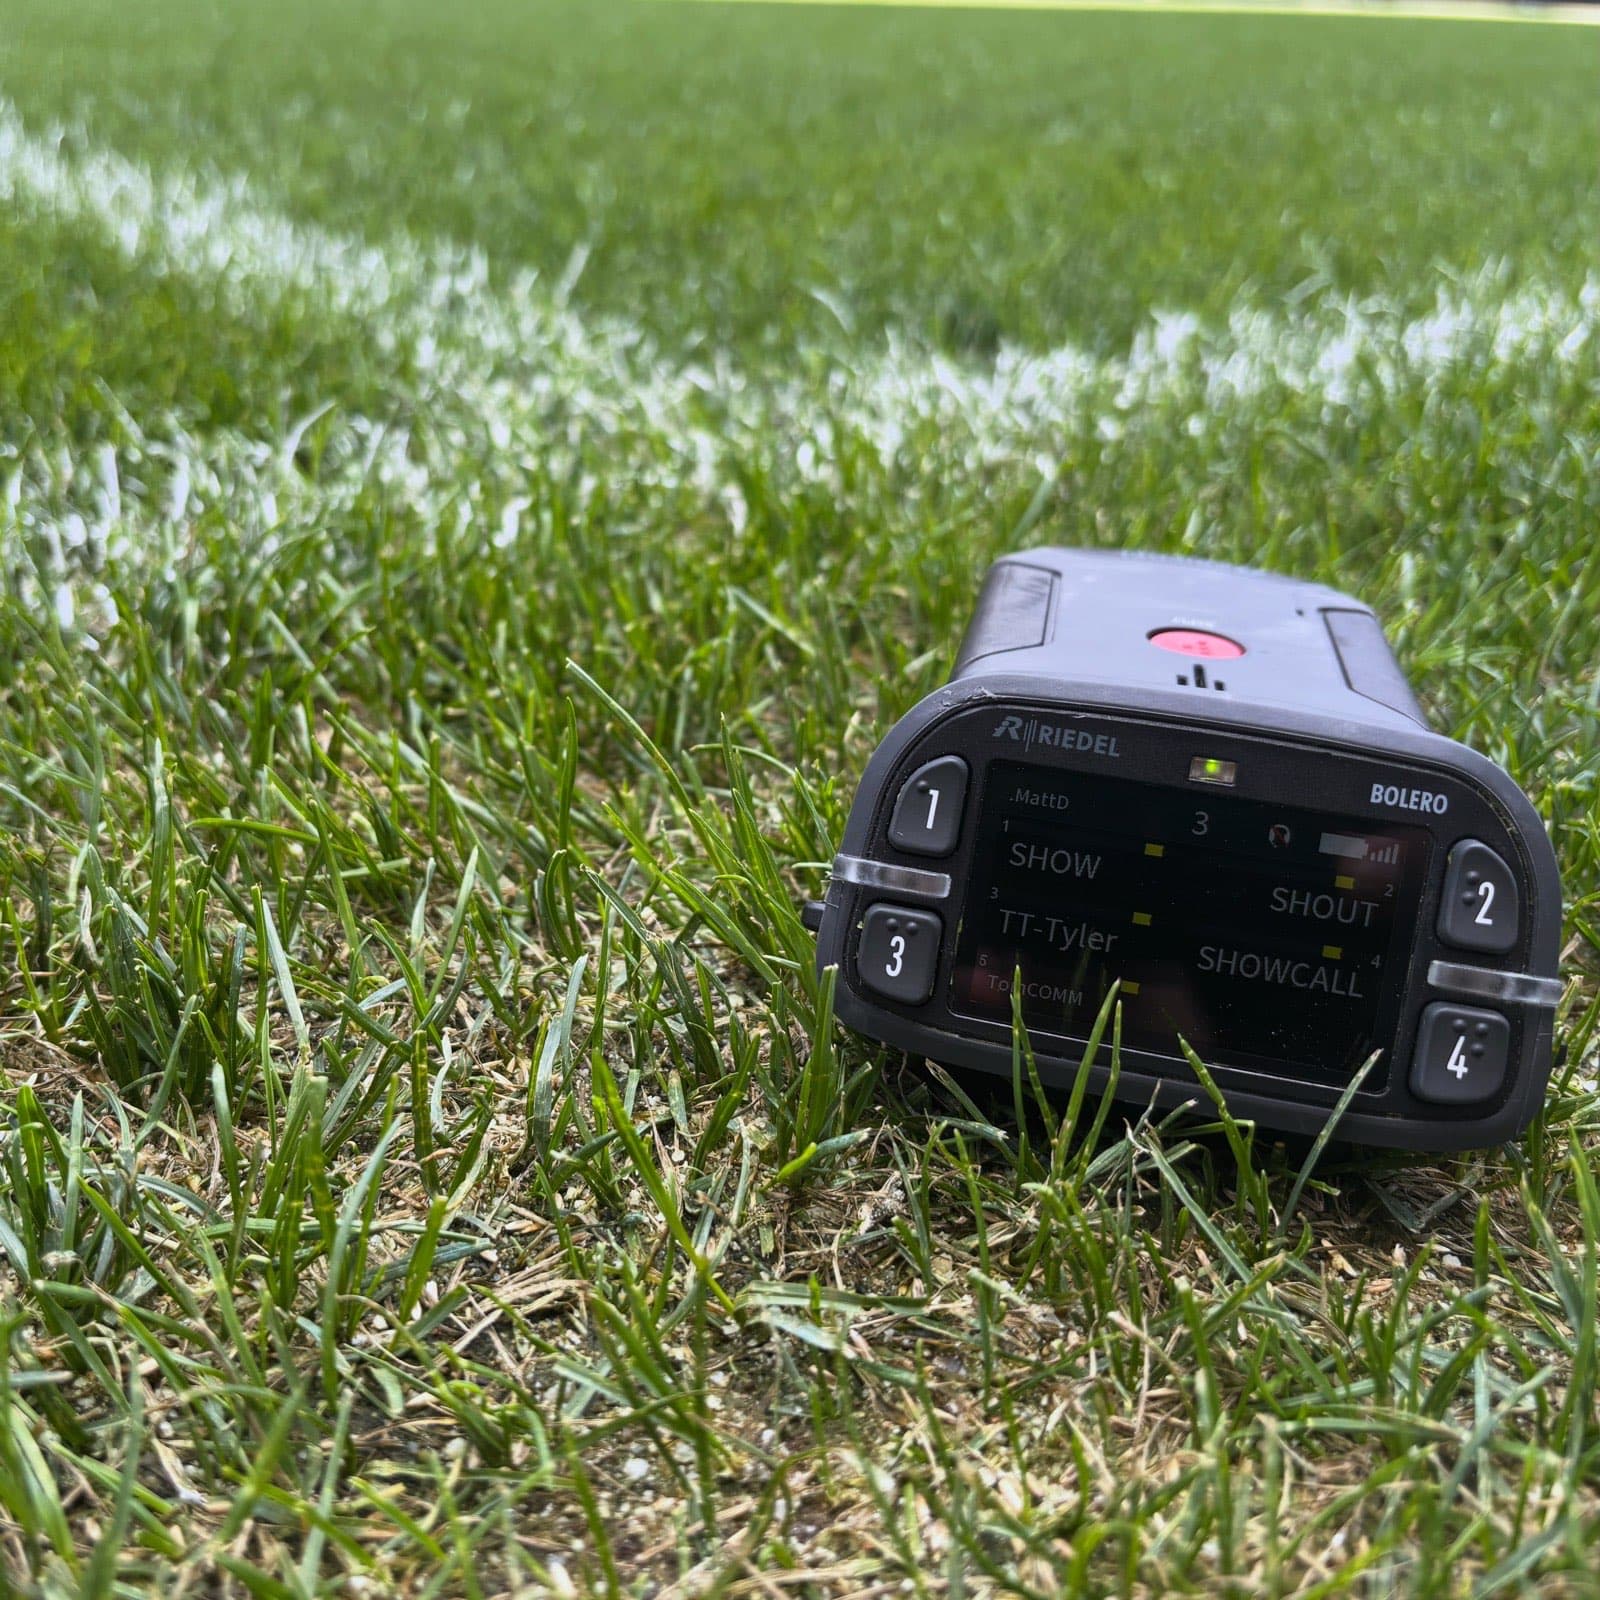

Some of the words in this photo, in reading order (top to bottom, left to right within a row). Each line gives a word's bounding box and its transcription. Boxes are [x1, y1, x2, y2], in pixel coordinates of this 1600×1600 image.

[1038, 724, 1120, 757] RIEDEL
[926, 789, 940, 830] 1
[1370, 783, 1448, 814] BOLERO
[1002, 819, 1009, 833] 1
[1191, 811, 1209, 836] 3
[1009, 842, 1101, 879] SHOW
[990, 887, 999, 900] 3
[1270, 887, 1379, 927] SHOUT
[1384, 884, 1394, 897] 2
[1475, 881, 1495, 925] 2
[1000, 908, 1119, 953] TT-Tyler
[886, 935, 905, 977] 3
[1197, 945, 1363, 998] SHOWCALL
[1371, 954, 1381, 968] 4
[1447, 1035, 1468, 1079] 4
